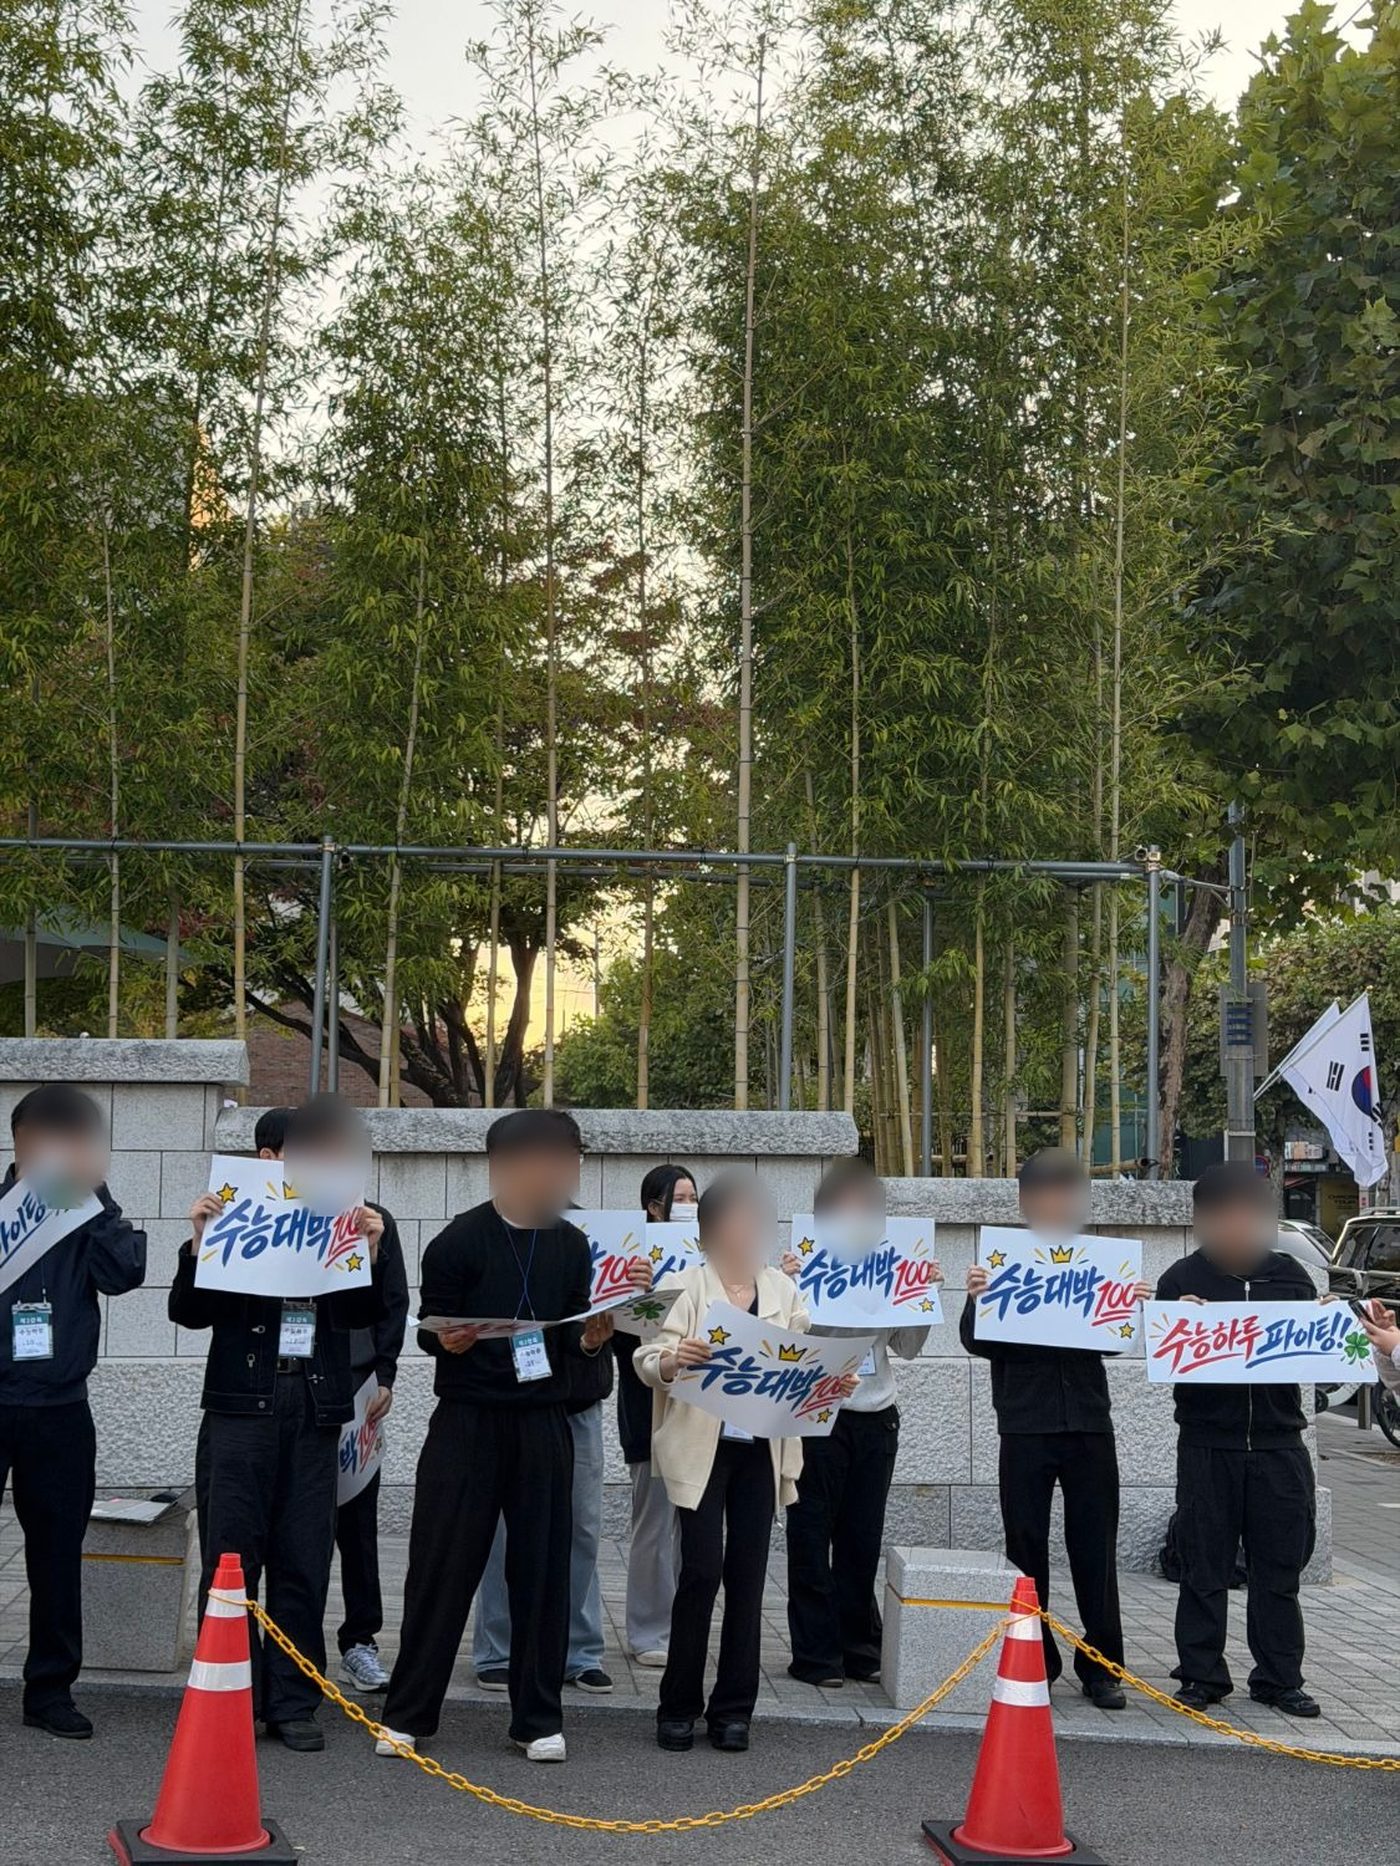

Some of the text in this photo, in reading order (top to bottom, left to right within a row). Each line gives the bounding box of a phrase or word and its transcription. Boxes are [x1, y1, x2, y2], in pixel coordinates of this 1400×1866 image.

[893, 1259, 932, 1297] 100
[981, 1262, 1138, 1322] 수능대박 100
[1153, 1315, 1265, 1376] 수능하루
[687, 1346, 828, 1412] 수능대박
